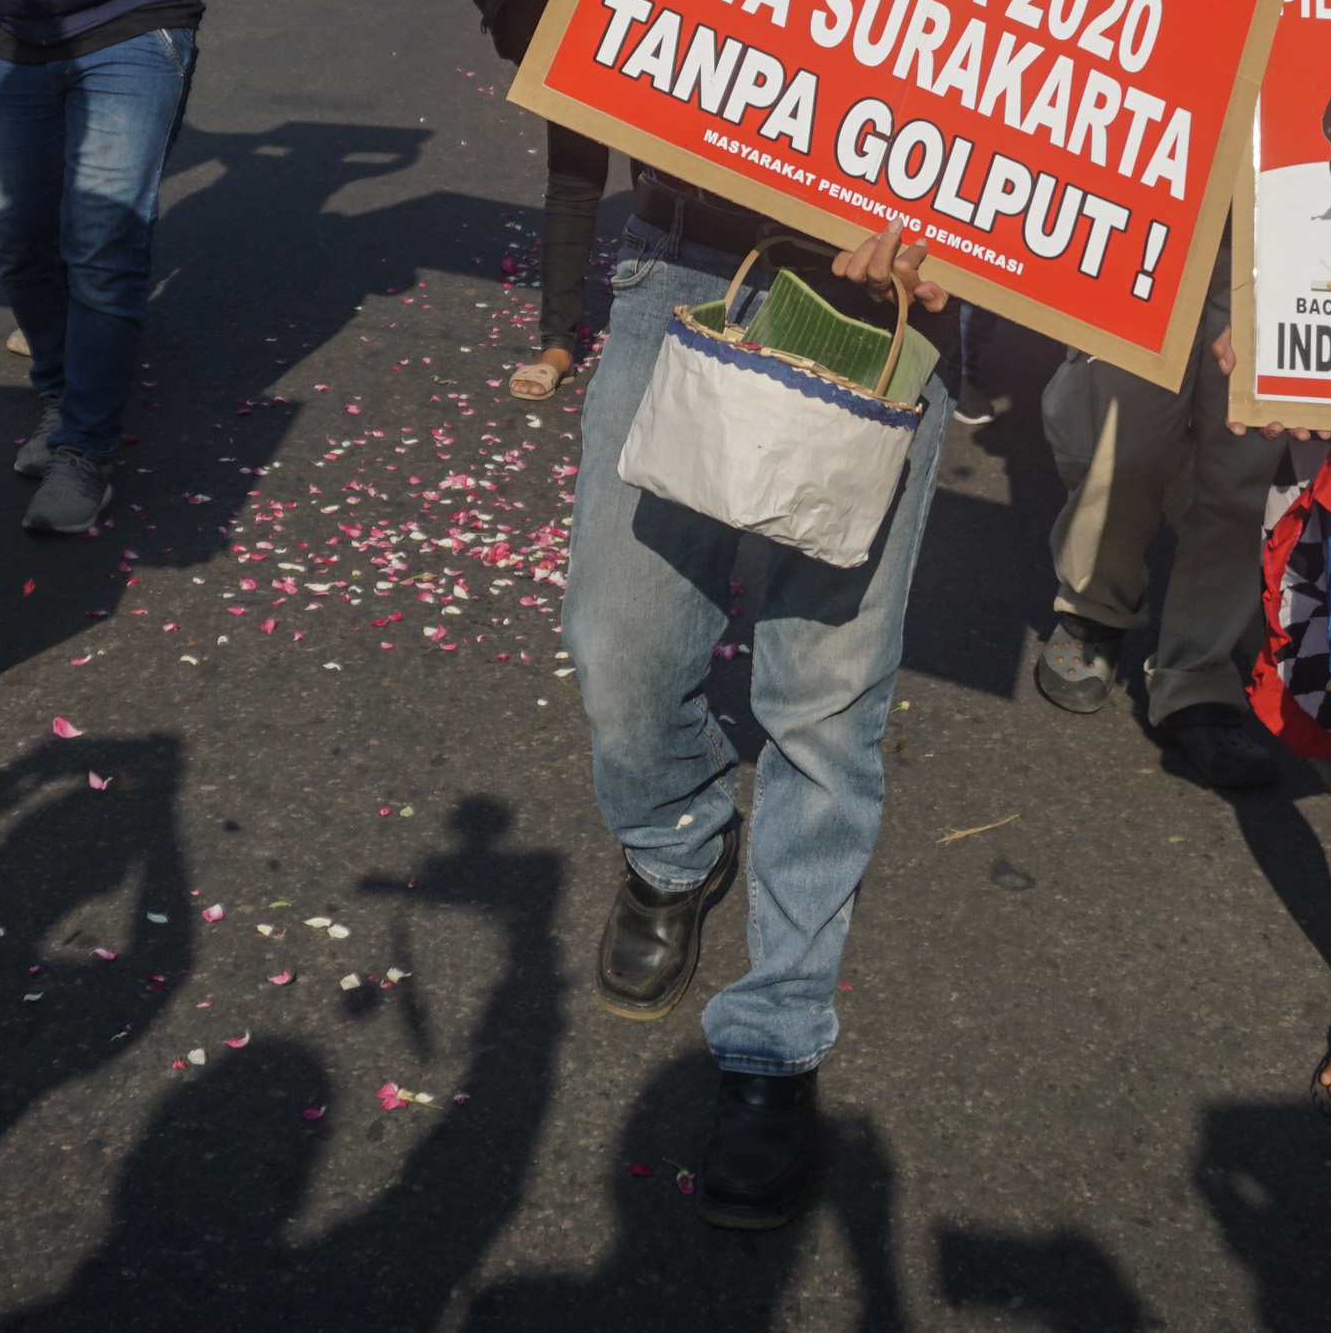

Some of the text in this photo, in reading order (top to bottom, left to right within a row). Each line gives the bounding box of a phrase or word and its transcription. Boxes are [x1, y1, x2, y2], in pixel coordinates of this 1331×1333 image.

[703, 129, 1025, 276] MASYARAKAT PENDUKUNG DEMOKRASI
[835, 99, 1129, 278] GOLPUT
